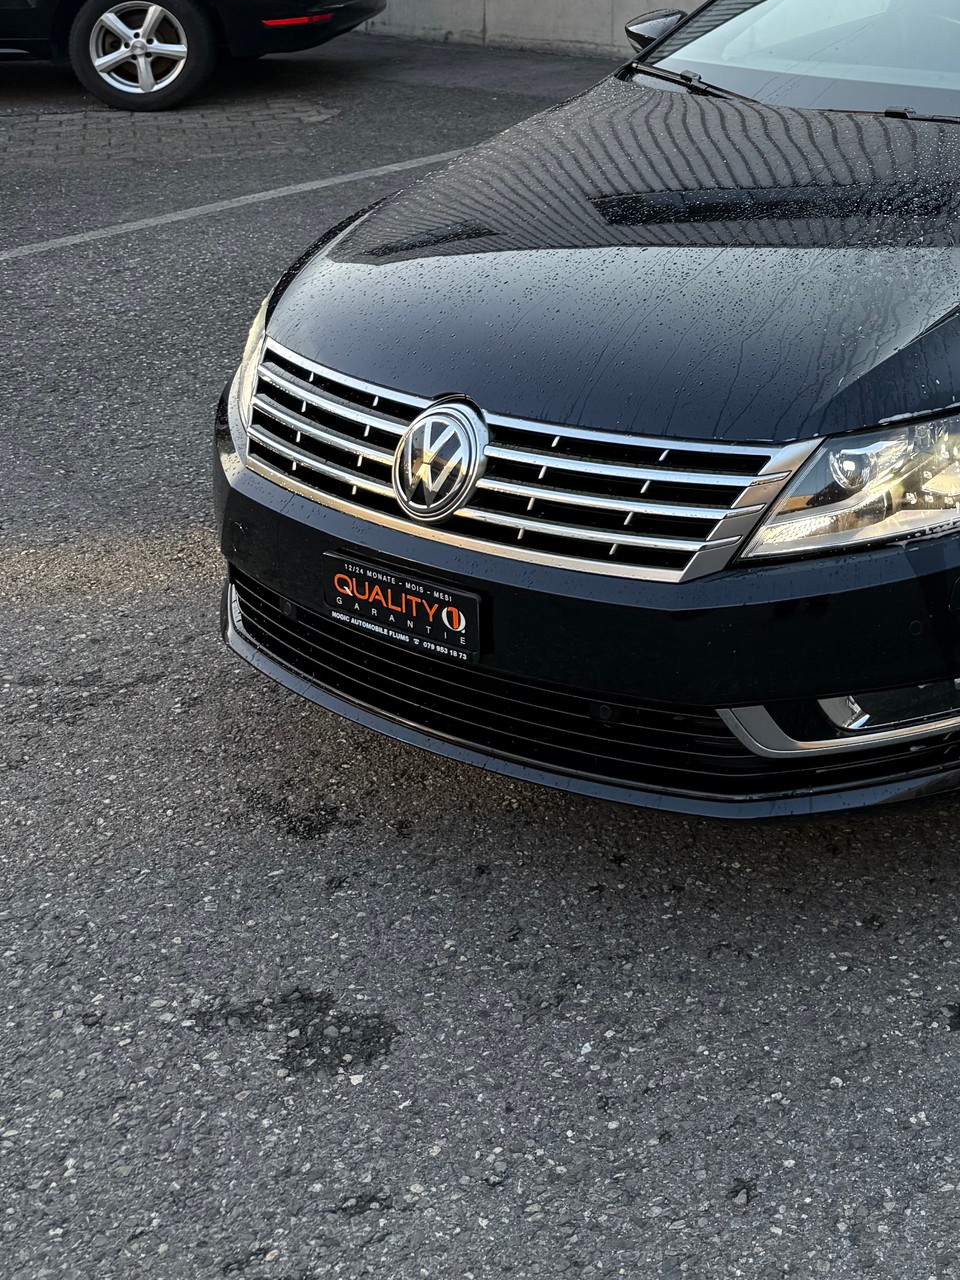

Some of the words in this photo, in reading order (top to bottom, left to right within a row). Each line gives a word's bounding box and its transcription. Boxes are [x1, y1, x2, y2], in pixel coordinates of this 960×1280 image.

[344, 563, 364, 575] 12/24
[366, 570, 396, 585] MONATE
[405, 581, 424, 594] MOIS
[433, 590, 453, 602] MESI
[336, 596, 466, 645] GARANTIE
[350, 617, 389, 636] AUTOMOBILE
[388, 630, 410, 642] FLUMS
[458, 652, 467, 660] 73
